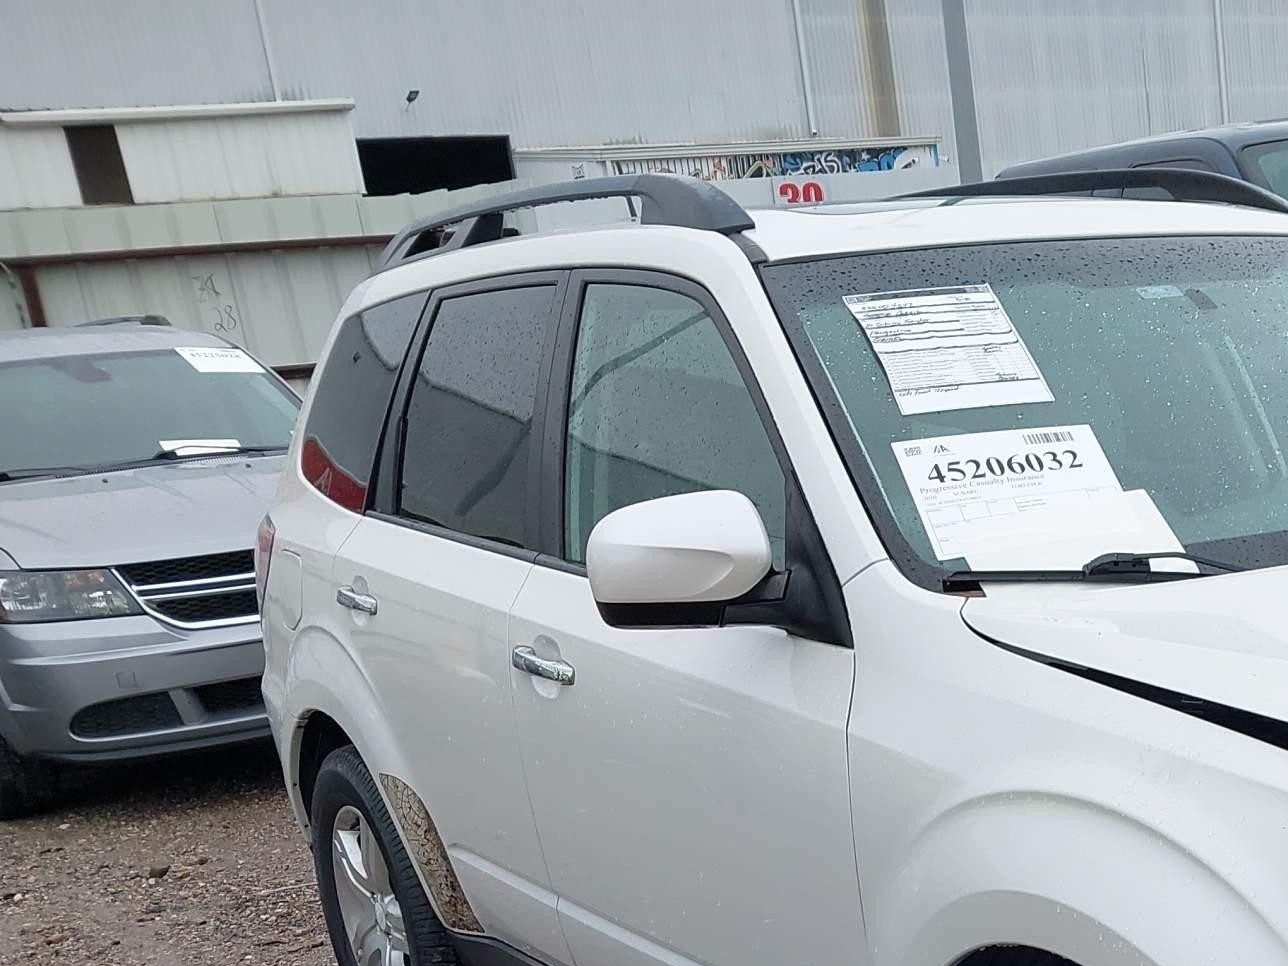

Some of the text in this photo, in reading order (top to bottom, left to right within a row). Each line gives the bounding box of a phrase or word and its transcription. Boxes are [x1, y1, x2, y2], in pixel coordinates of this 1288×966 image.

[927, 449, 1084, 484] 45206032
[919, 480, 968, 495] Progressive
[969, 475, 1005, 489] Casualty
